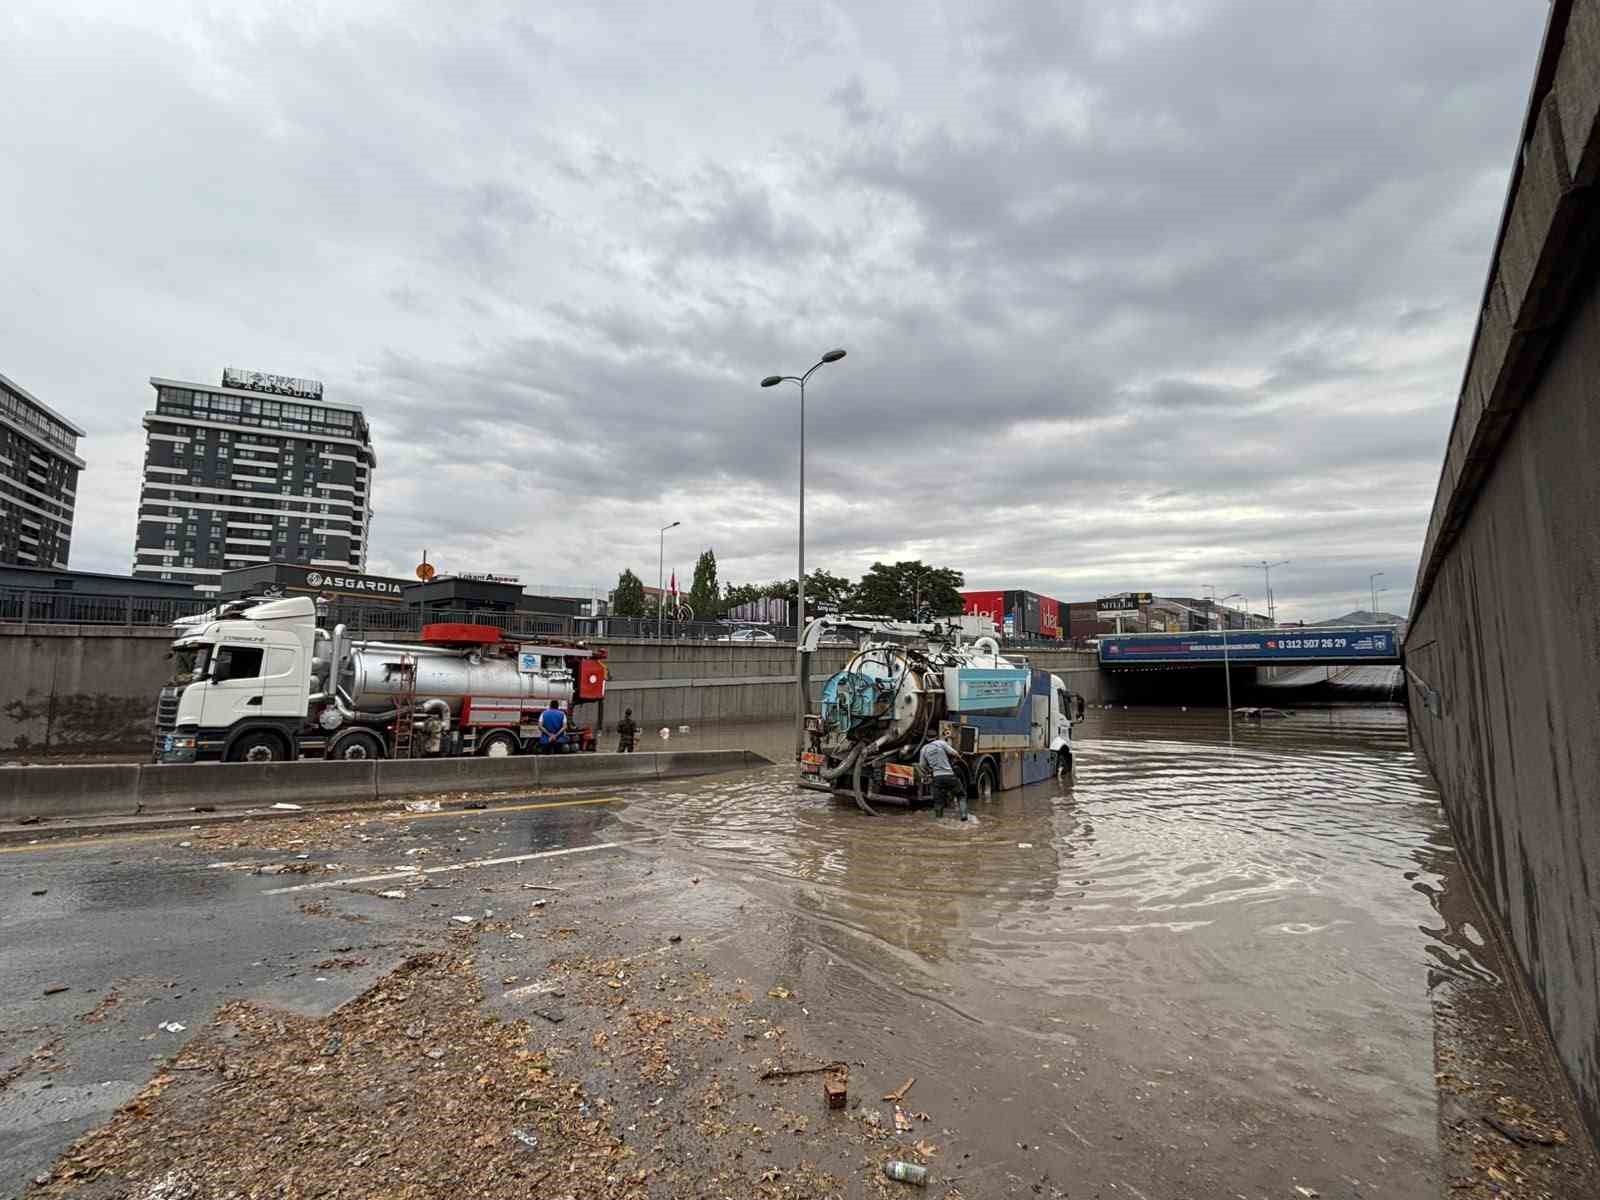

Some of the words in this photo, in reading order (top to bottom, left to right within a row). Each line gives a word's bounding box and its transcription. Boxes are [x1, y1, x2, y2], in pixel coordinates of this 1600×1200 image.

[323, 576, 401, 593] ASGARDIA
[1278, 640, 1285, 649] 0
[1286, 640, 1302, 649] 312
[1303, 640, 1319, 649] 507
[1321, 639, 1333, 648] 26
[1335, 638, 1347, 648] 29
